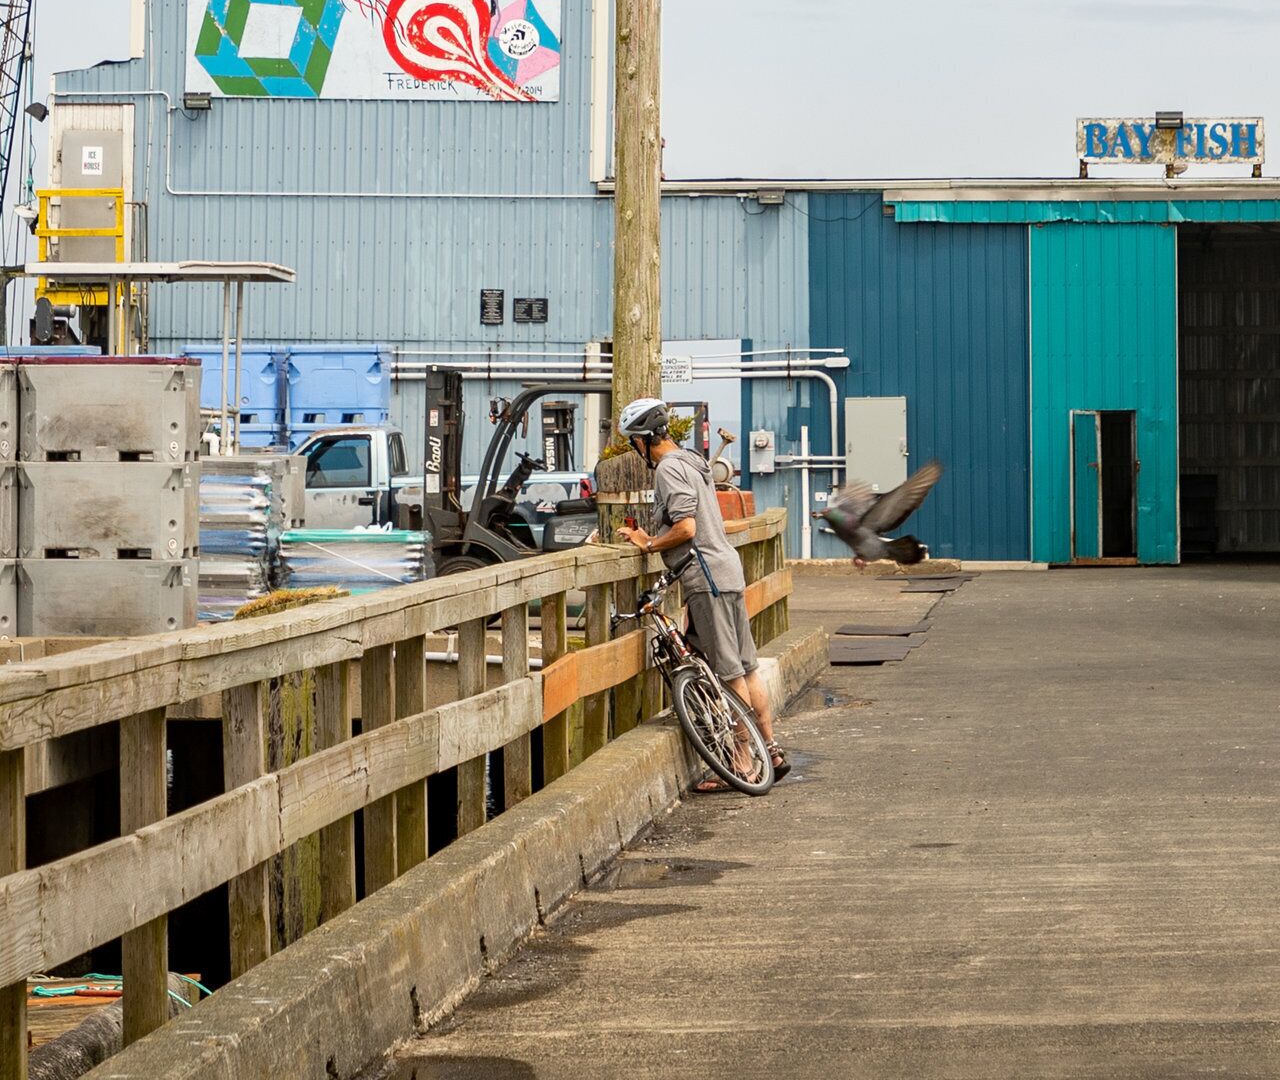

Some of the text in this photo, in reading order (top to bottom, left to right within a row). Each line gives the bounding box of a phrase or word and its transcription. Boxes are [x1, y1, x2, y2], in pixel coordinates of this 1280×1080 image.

[382, 72, 459, 94] FREDERICK
[1083, 121, 1259, 159] BAY FISH
